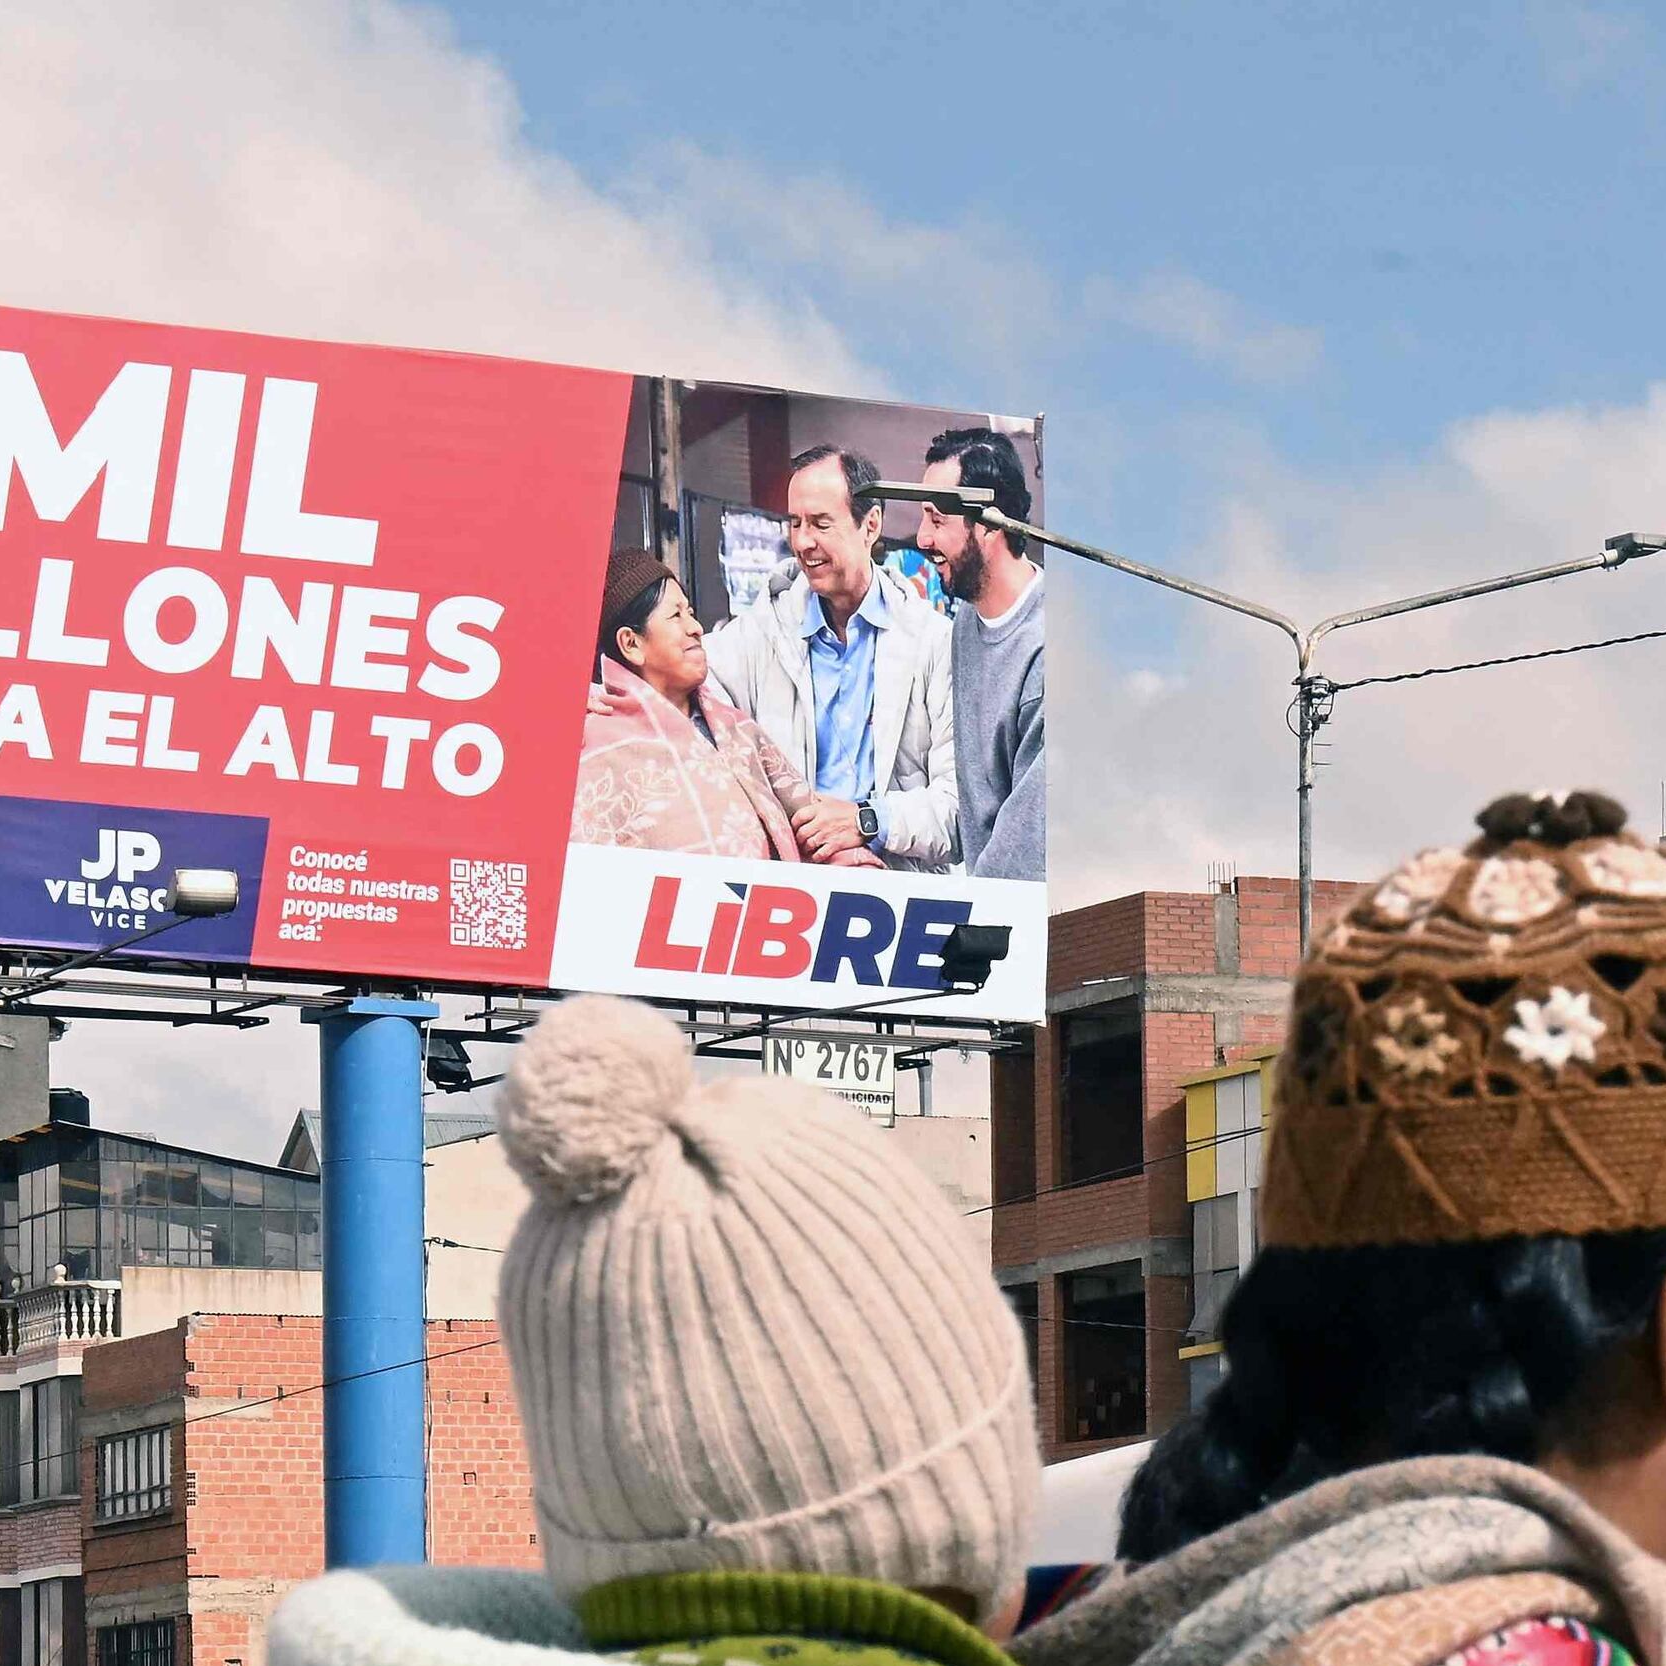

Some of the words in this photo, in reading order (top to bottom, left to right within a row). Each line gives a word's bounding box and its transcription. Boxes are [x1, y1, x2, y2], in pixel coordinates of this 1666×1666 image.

[79, 689, 200, 772] EL
[223, 704, 504, 798] ALTO
[81, 829, 161, 883] JP
[289, 845, 368, 872] Conocé
[44, 879, 169, 914] VELASC
[286, 871, 345, 895] todas
[350, 879, 440, 903] nuestras
[91, 910, 147, 931] VICE
[281, 898, 398, 924] propuestas
[278, 918, 323, 942] acá:
[816, 1041, 888, 1082] 2767
